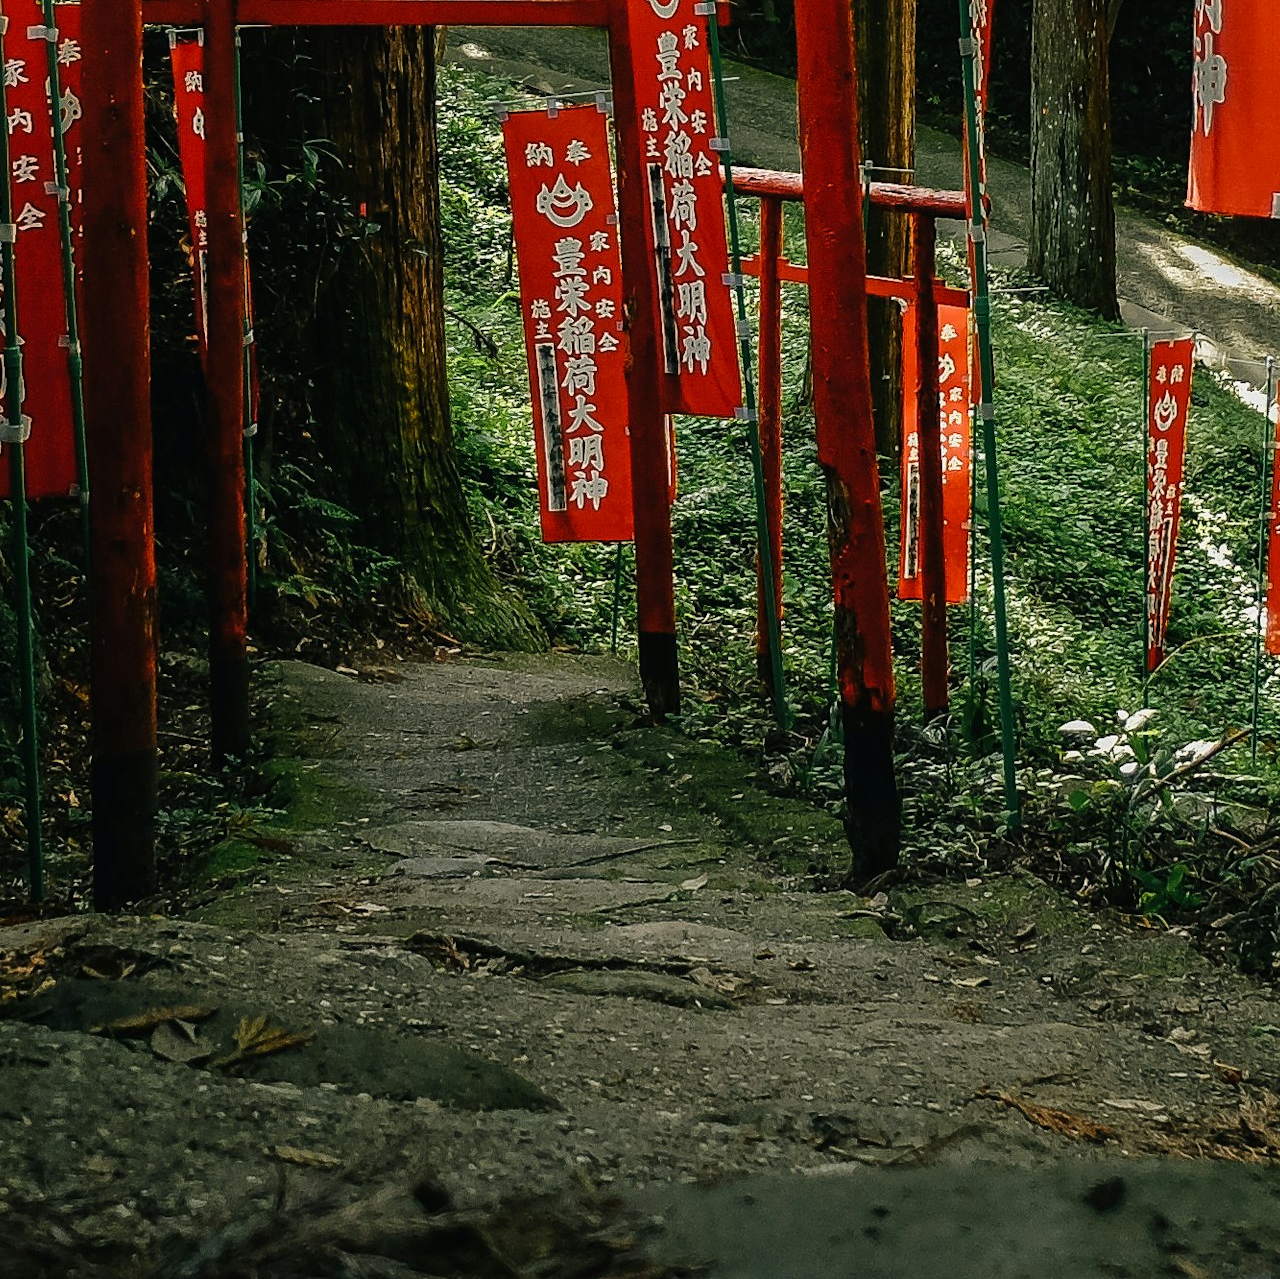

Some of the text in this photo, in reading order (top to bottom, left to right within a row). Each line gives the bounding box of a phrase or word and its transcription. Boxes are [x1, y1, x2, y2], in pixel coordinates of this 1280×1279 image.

[4, 58, 46, 231] 家内安全
[642, 107, 661, 159] 施主
[681, 23, 713, 177] 家内安全
[656, 32, 712, 376] 豊栄稲荷大明神
[530, 298, 553, 340] 施主
[588, 230, 620, 353] 家内安全
[551, 237, 609, 511] 豊栄稲荷大明神
